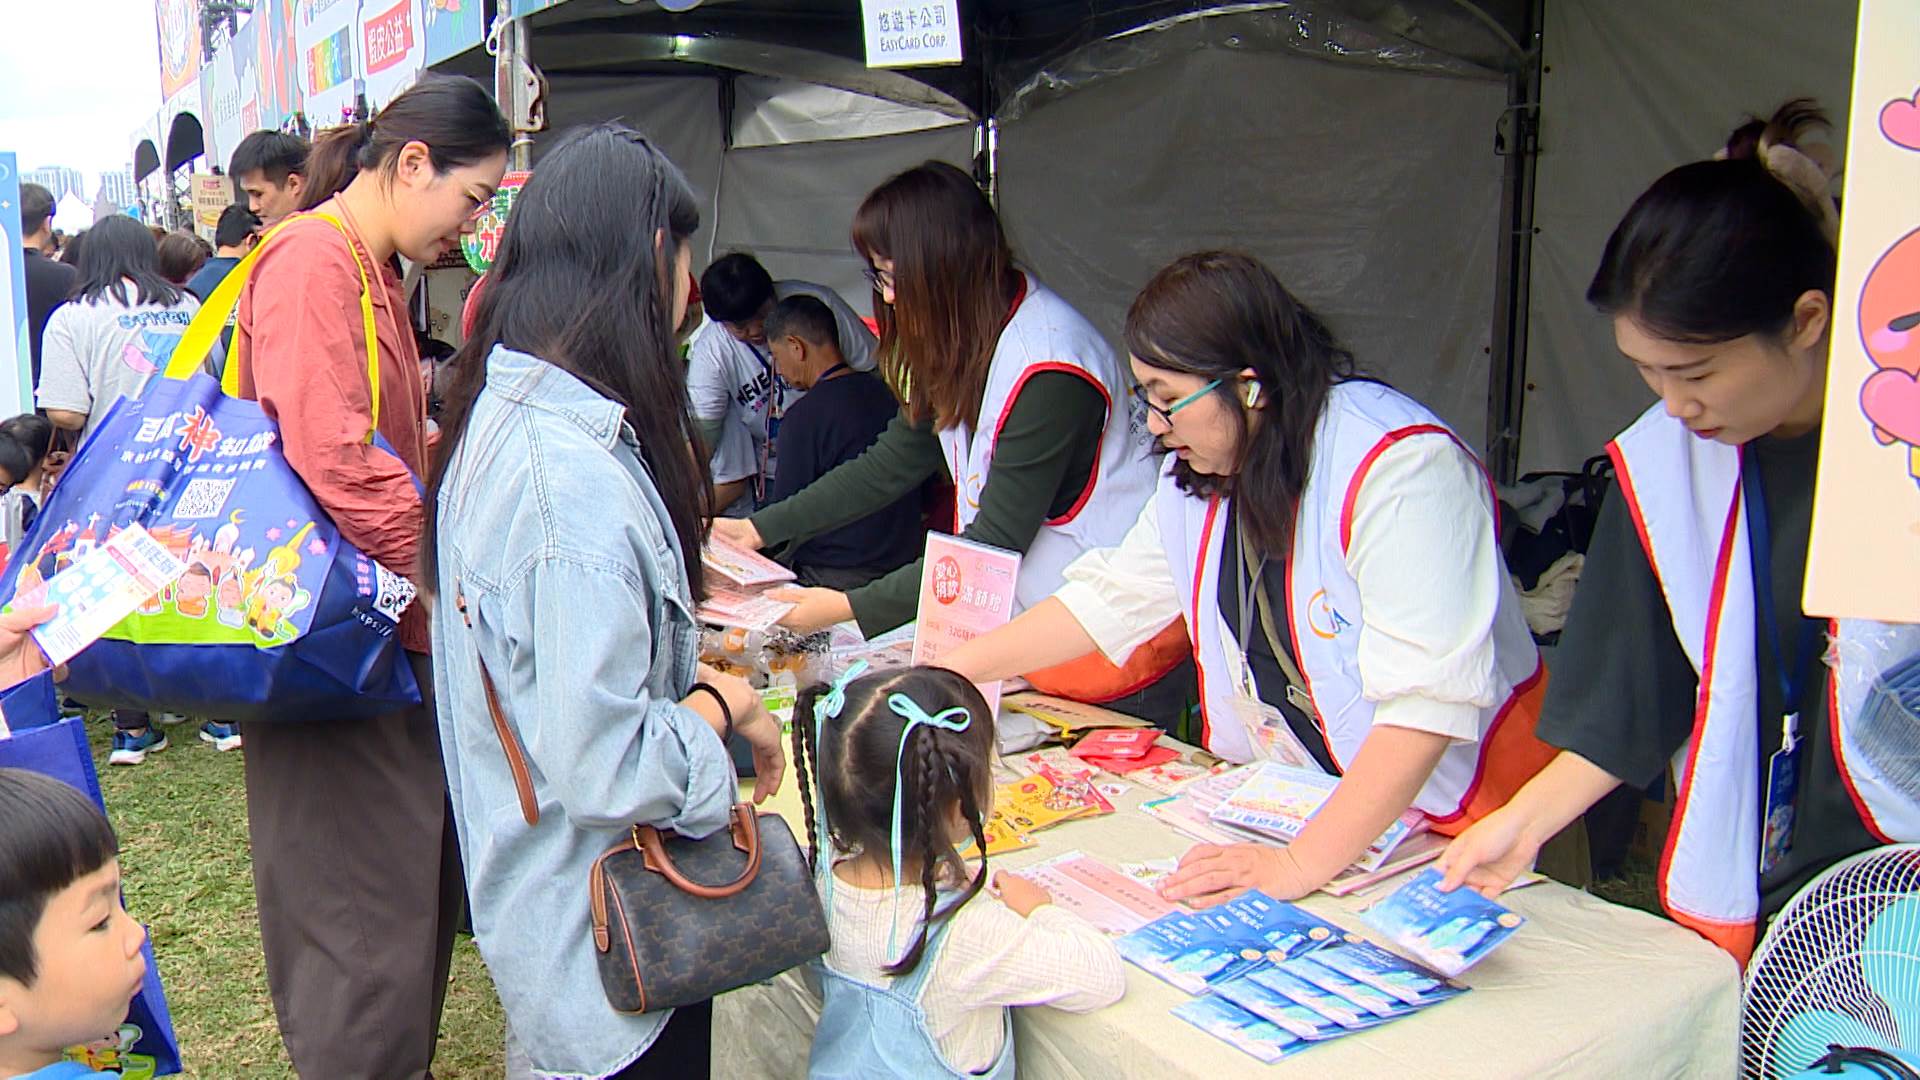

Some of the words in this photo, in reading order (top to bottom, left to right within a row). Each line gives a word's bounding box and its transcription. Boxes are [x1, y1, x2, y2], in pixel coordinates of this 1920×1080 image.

[878, 5, 947, 32] 悠遊卡公司
[367, 15, 405, 65] 蝦皮公益
[936, 579, 959, 598] 捐款
